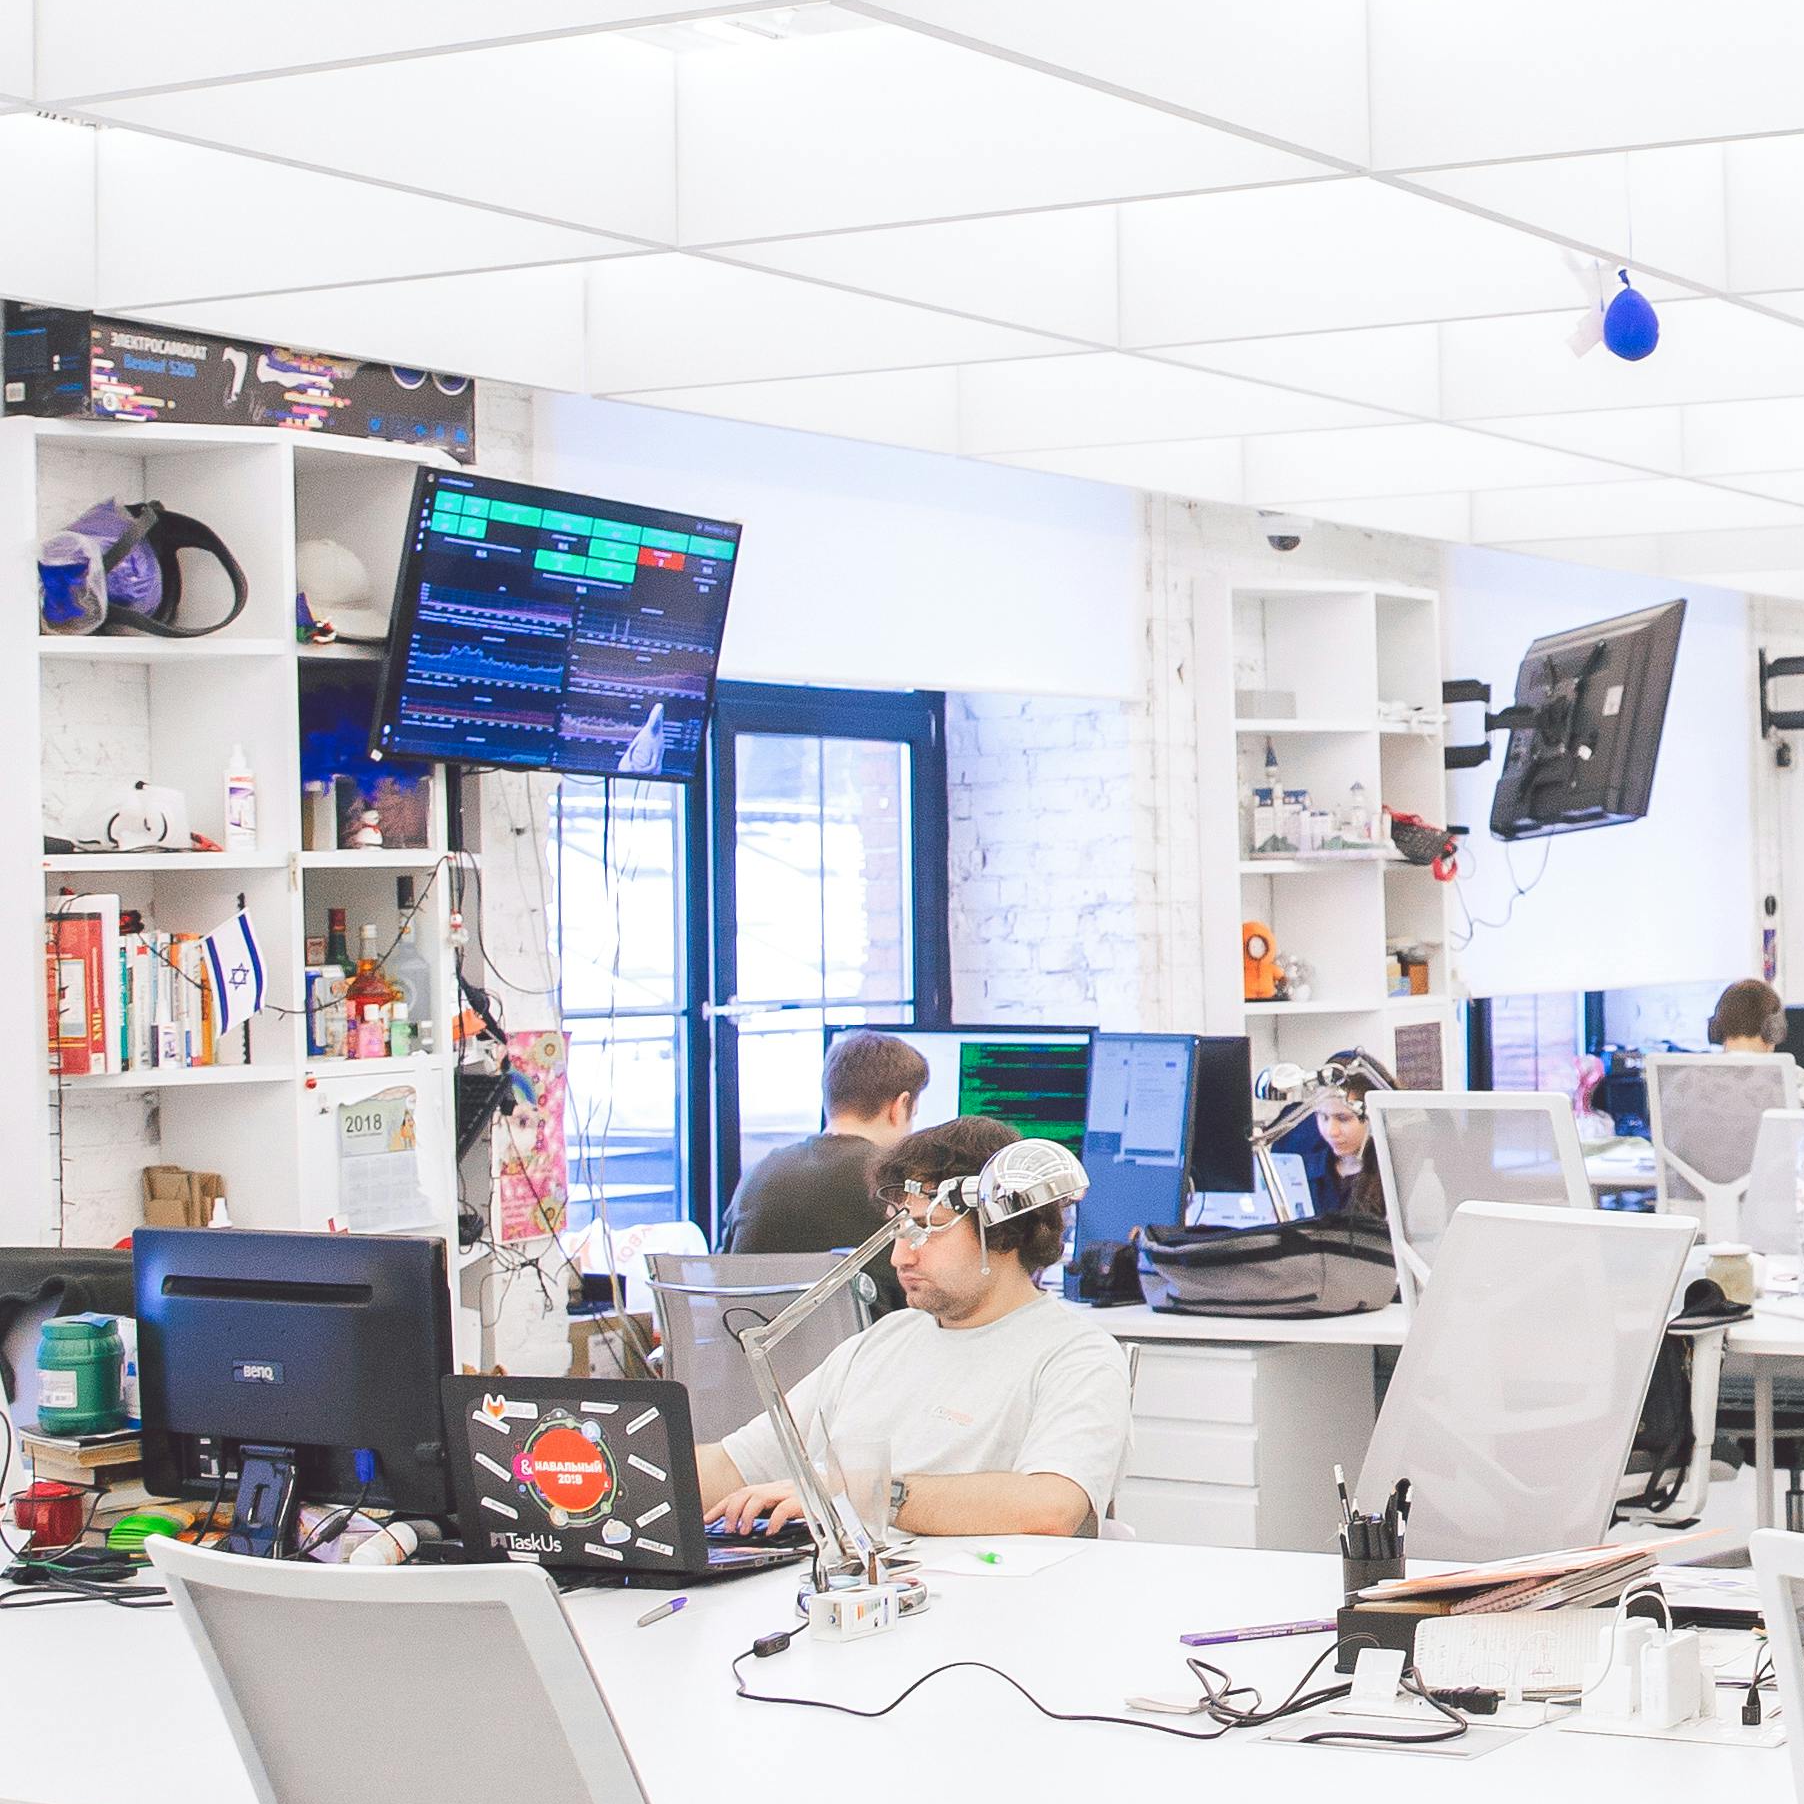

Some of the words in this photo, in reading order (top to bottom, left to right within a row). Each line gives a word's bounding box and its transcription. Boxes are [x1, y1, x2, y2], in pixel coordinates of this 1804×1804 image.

[345, 1113, 382, 1133] 2018
[243, 1365, 275, 1381] BenQ
[534, 1459, 603, 1474] НАВАЛЬНЫЙ
[557, 1473, 583, 1485] 2018
[506, 1531, 563, 1553] TaskUs
